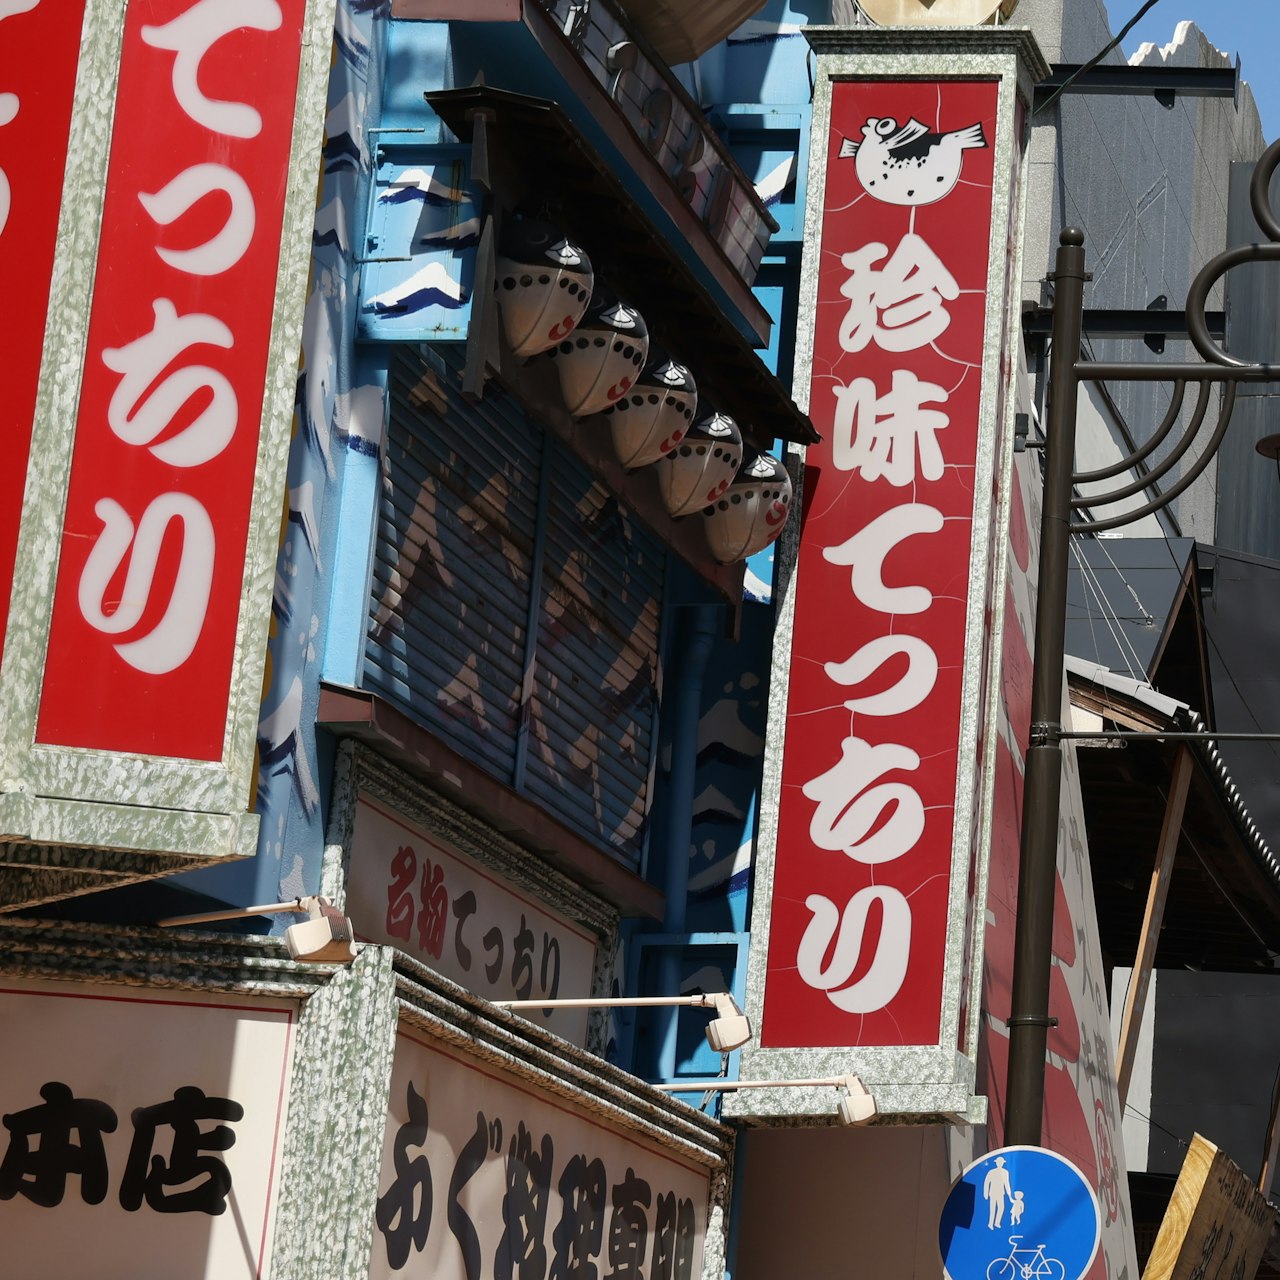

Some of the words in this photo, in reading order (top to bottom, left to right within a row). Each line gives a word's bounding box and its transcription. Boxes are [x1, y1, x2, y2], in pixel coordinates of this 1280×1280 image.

[796, 233, 960, 1015] 珍味てっちり
[385, 846, 561, 1018] 名物てっちり
[0, 1082, 244, 1217] 本店
